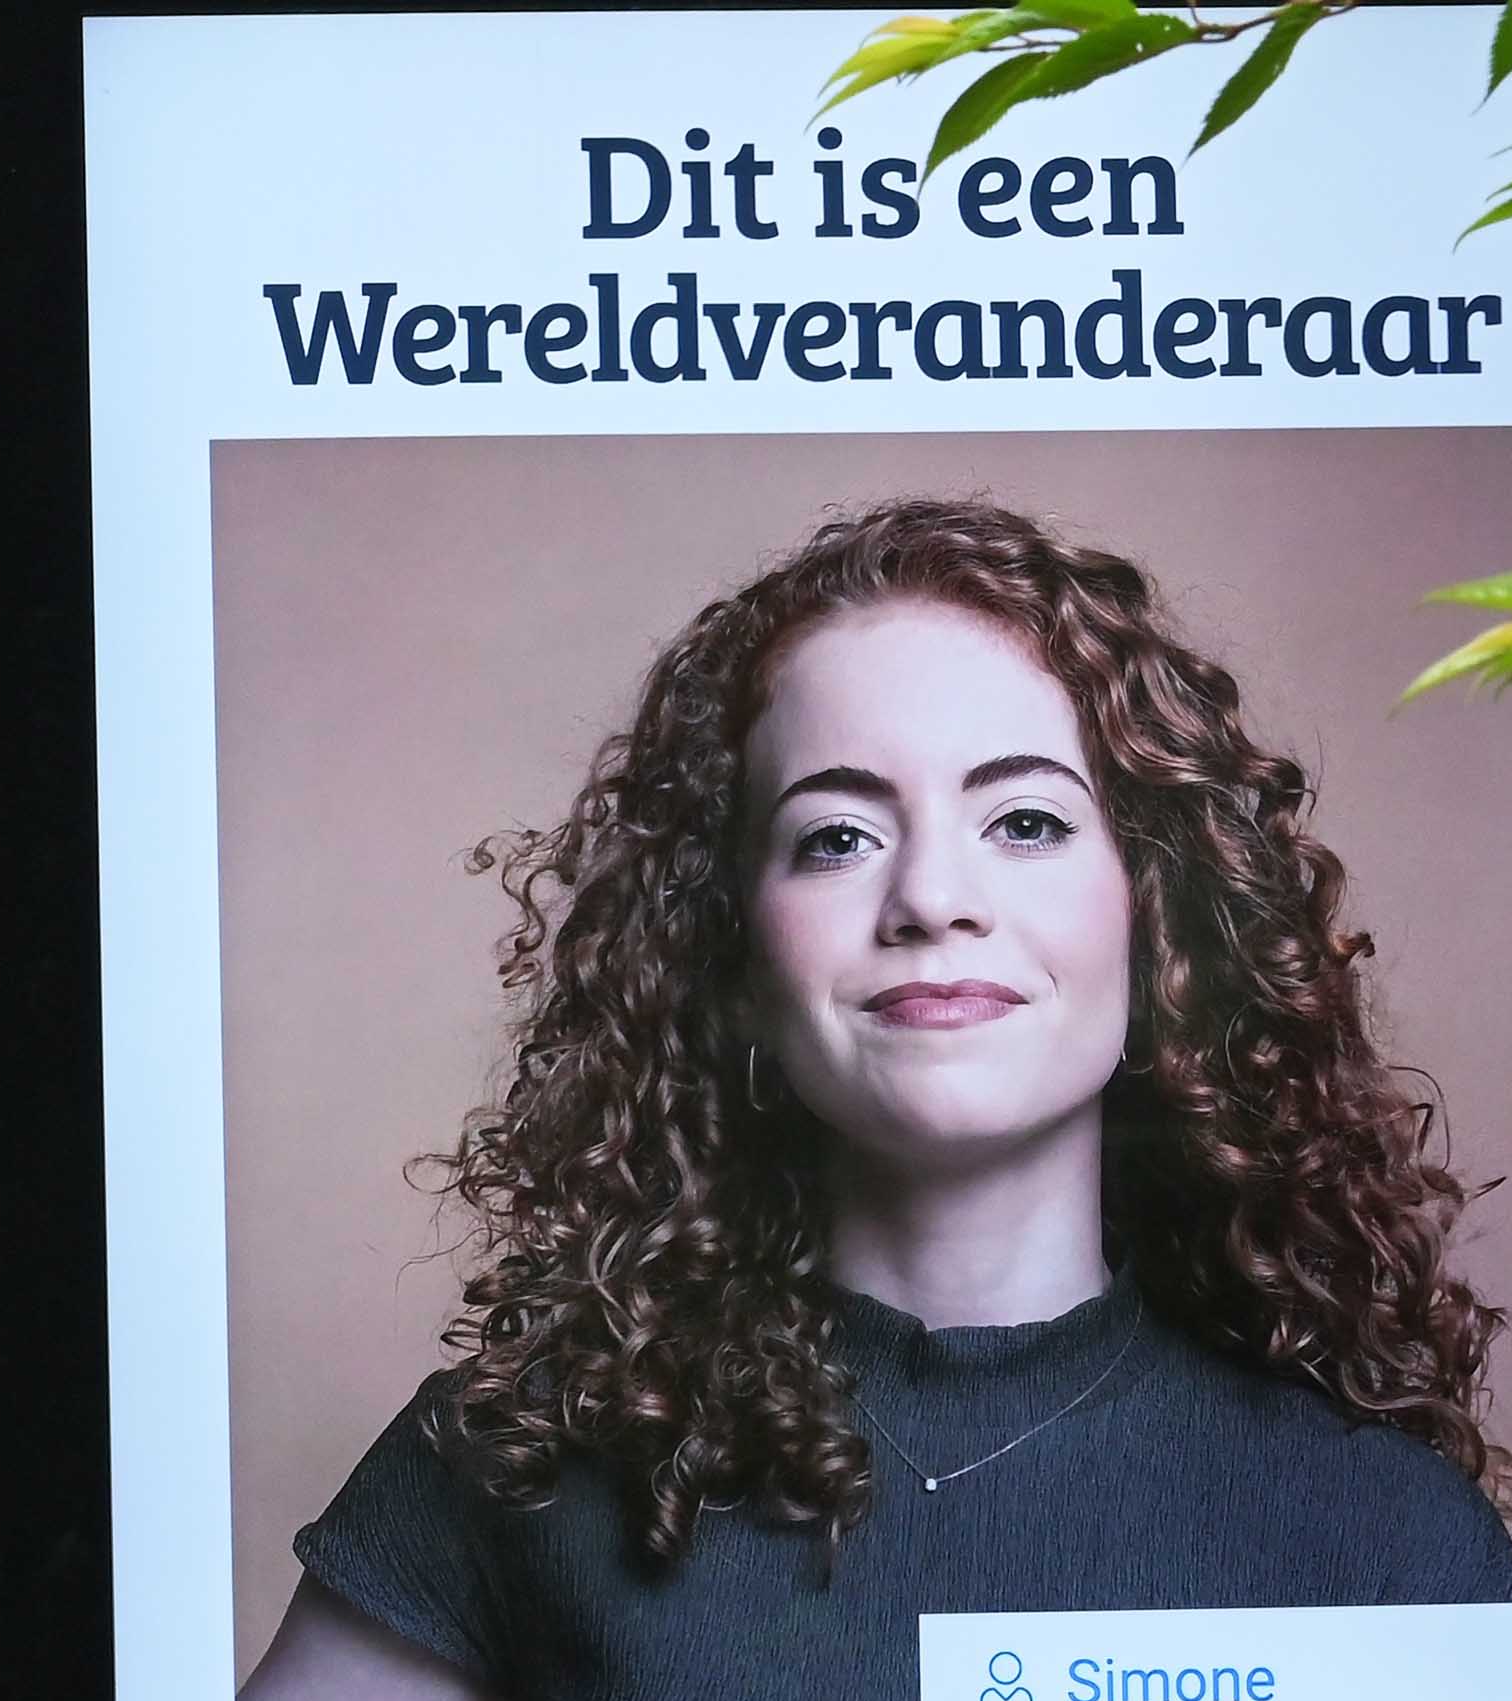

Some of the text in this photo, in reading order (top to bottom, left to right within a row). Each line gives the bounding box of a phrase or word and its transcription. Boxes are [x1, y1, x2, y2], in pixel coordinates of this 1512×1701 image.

[581, 128, 1185, 239] Dit is een
[263, 268, 1502, 386] Wereldveranderaar
